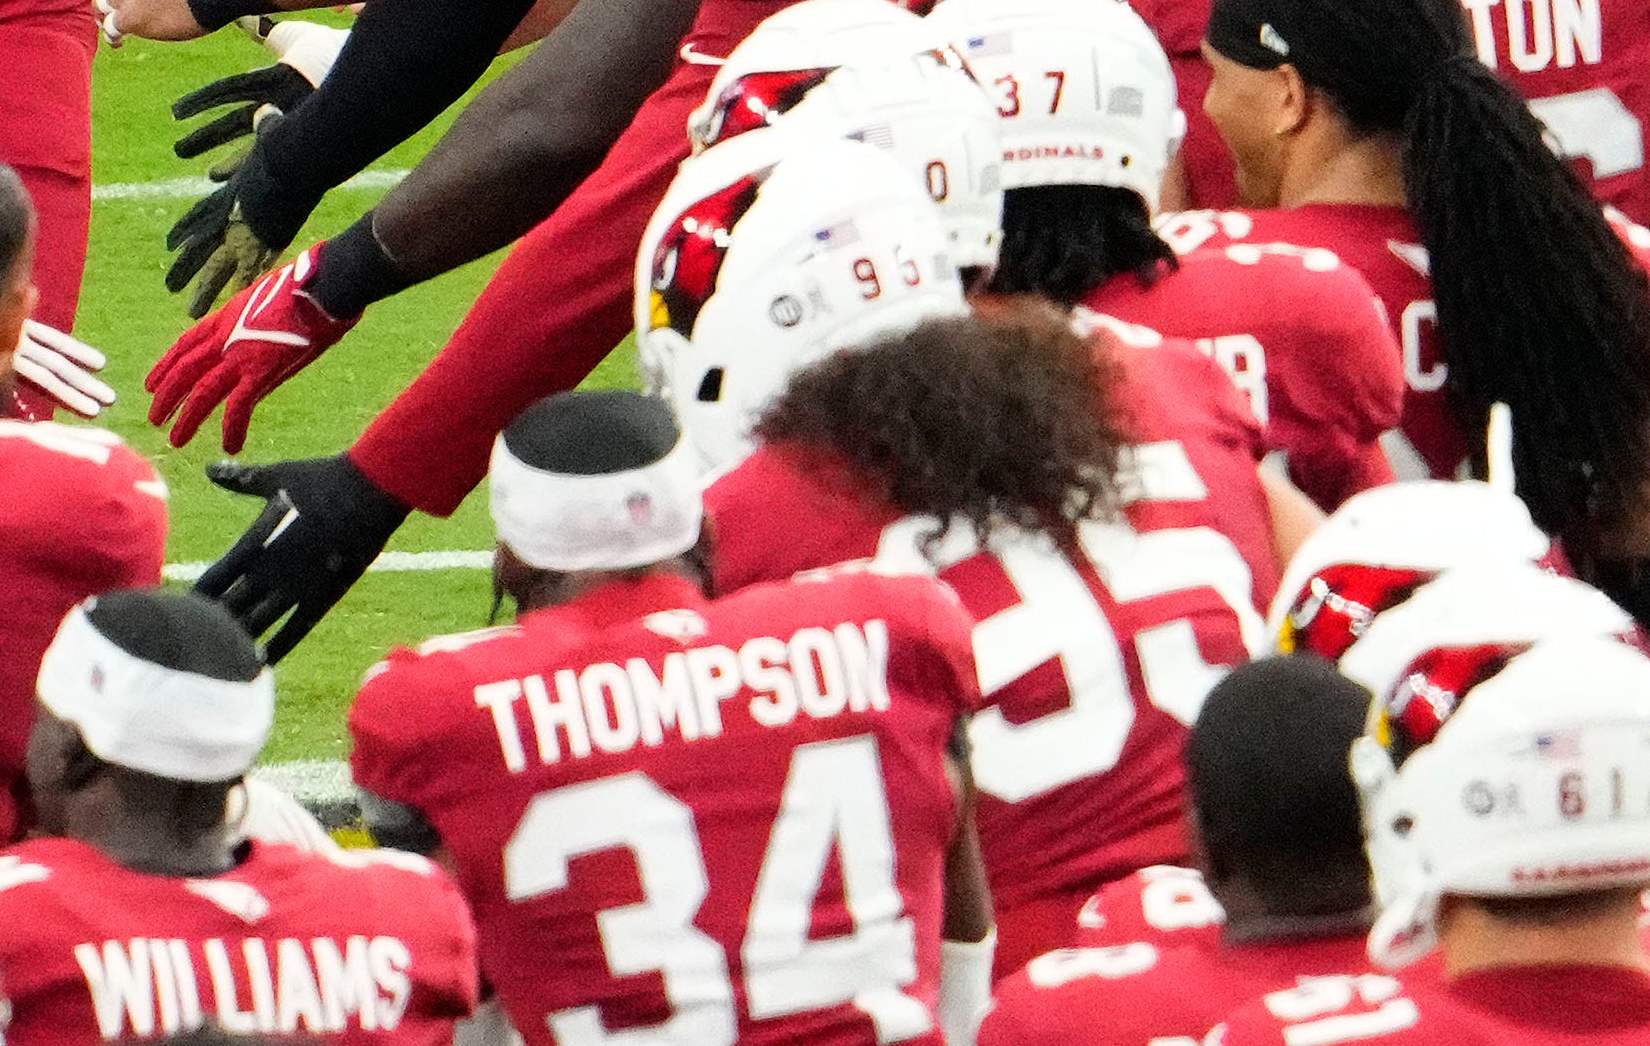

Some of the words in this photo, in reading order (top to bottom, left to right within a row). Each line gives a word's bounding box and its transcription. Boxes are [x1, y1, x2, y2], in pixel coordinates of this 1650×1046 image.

[994, 70, 1066, 118] 37
[1002, 144, 1105, 162] RDINALS
[473, 618, 891, 774] THOMPSON
[503, 731, 933, 1046] 34
[73, 934, 412, 1039] WILLIAMS
